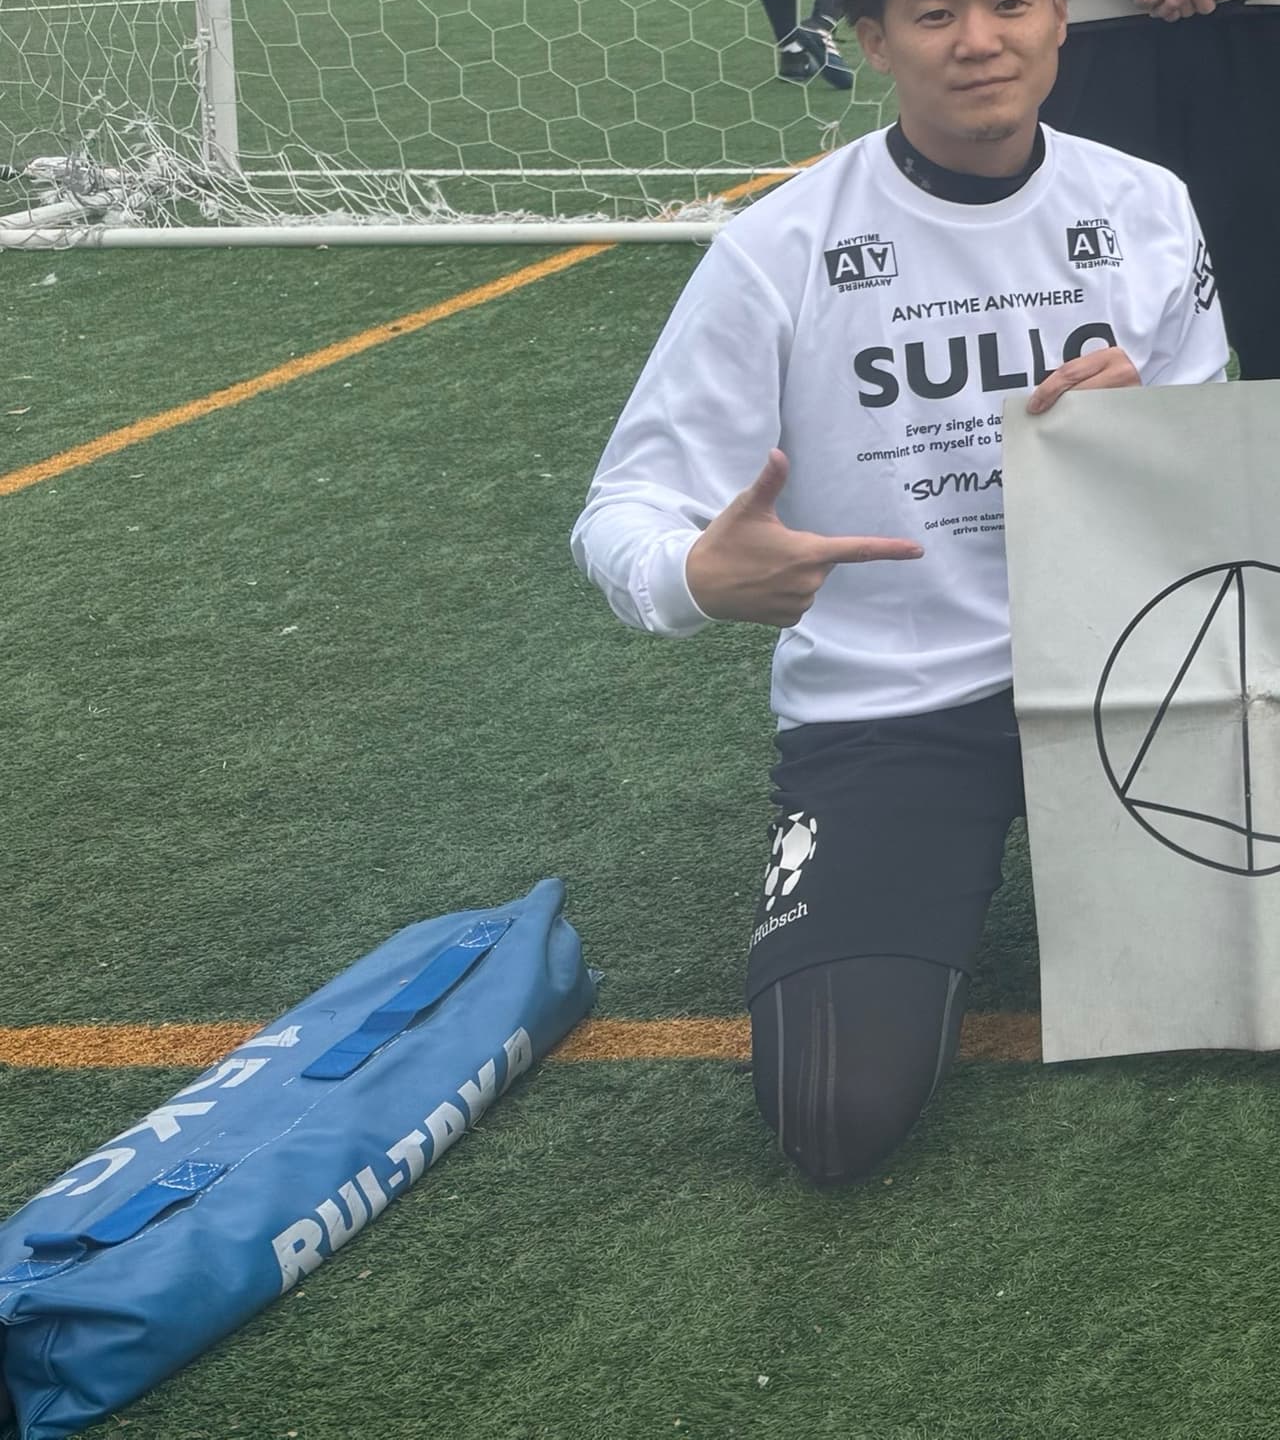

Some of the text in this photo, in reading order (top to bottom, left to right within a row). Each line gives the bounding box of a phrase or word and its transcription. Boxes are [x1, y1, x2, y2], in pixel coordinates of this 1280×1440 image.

[836, 233, 881, 248] ANYTIME
[838, 277, 893, 293] ANYWHERE
[892, 288, 1084, 323] ANYTIME ANYWHERE
[905, 413, 1004, 438] Every single da
[912, 443, 926, 454] to
[929, 434, 975, 453] myself
[978, 436, 992, 446] to
[271, 1026, 534, 1296] RUI-TAKA
